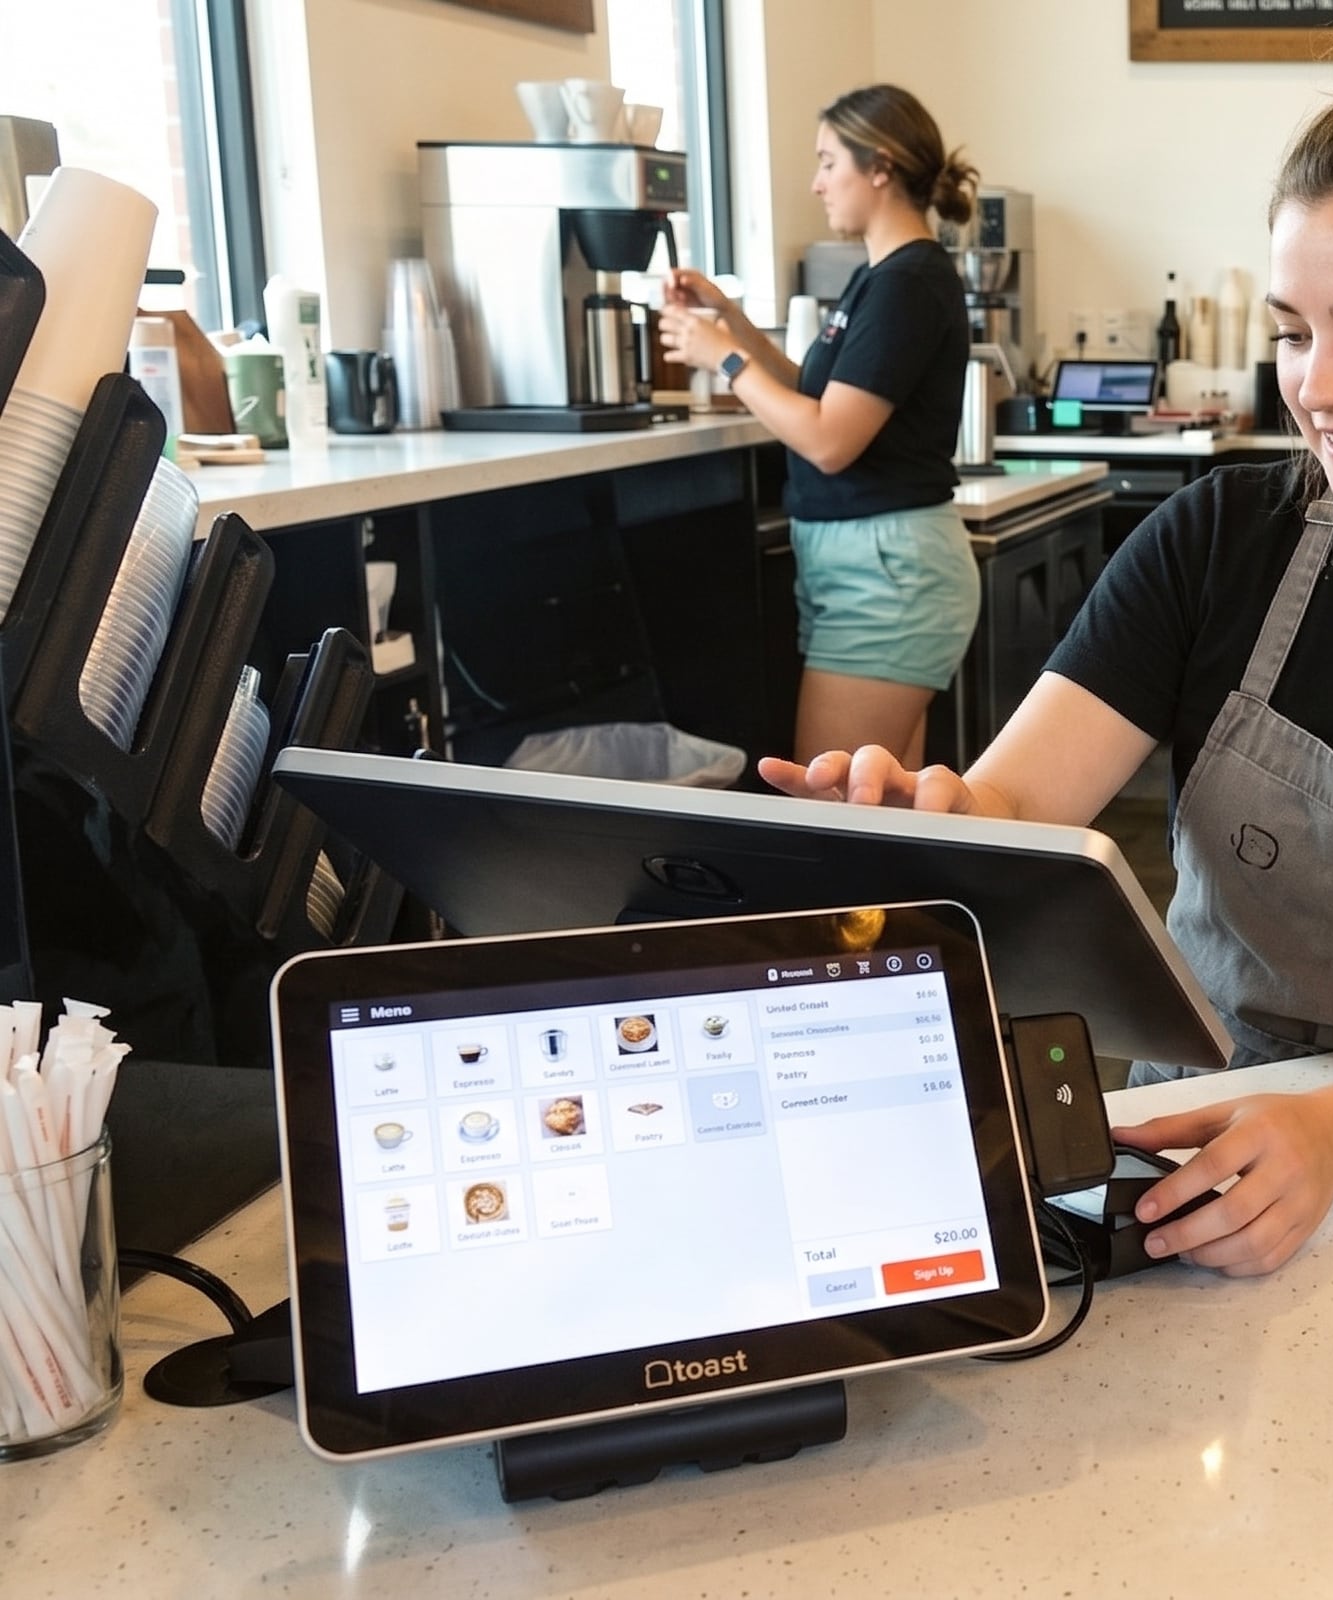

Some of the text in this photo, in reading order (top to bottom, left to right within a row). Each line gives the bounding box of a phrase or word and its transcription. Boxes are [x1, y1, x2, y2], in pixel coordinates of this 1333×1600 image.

[820, 1093, 848, 1105] Order
[934, 1227, 978, 1245] $20.00
[804, 1248, 836, 1263] Total
[913, 1265, 954, 1283] Sign Up
[673, 1349, 749, 1382] toast
